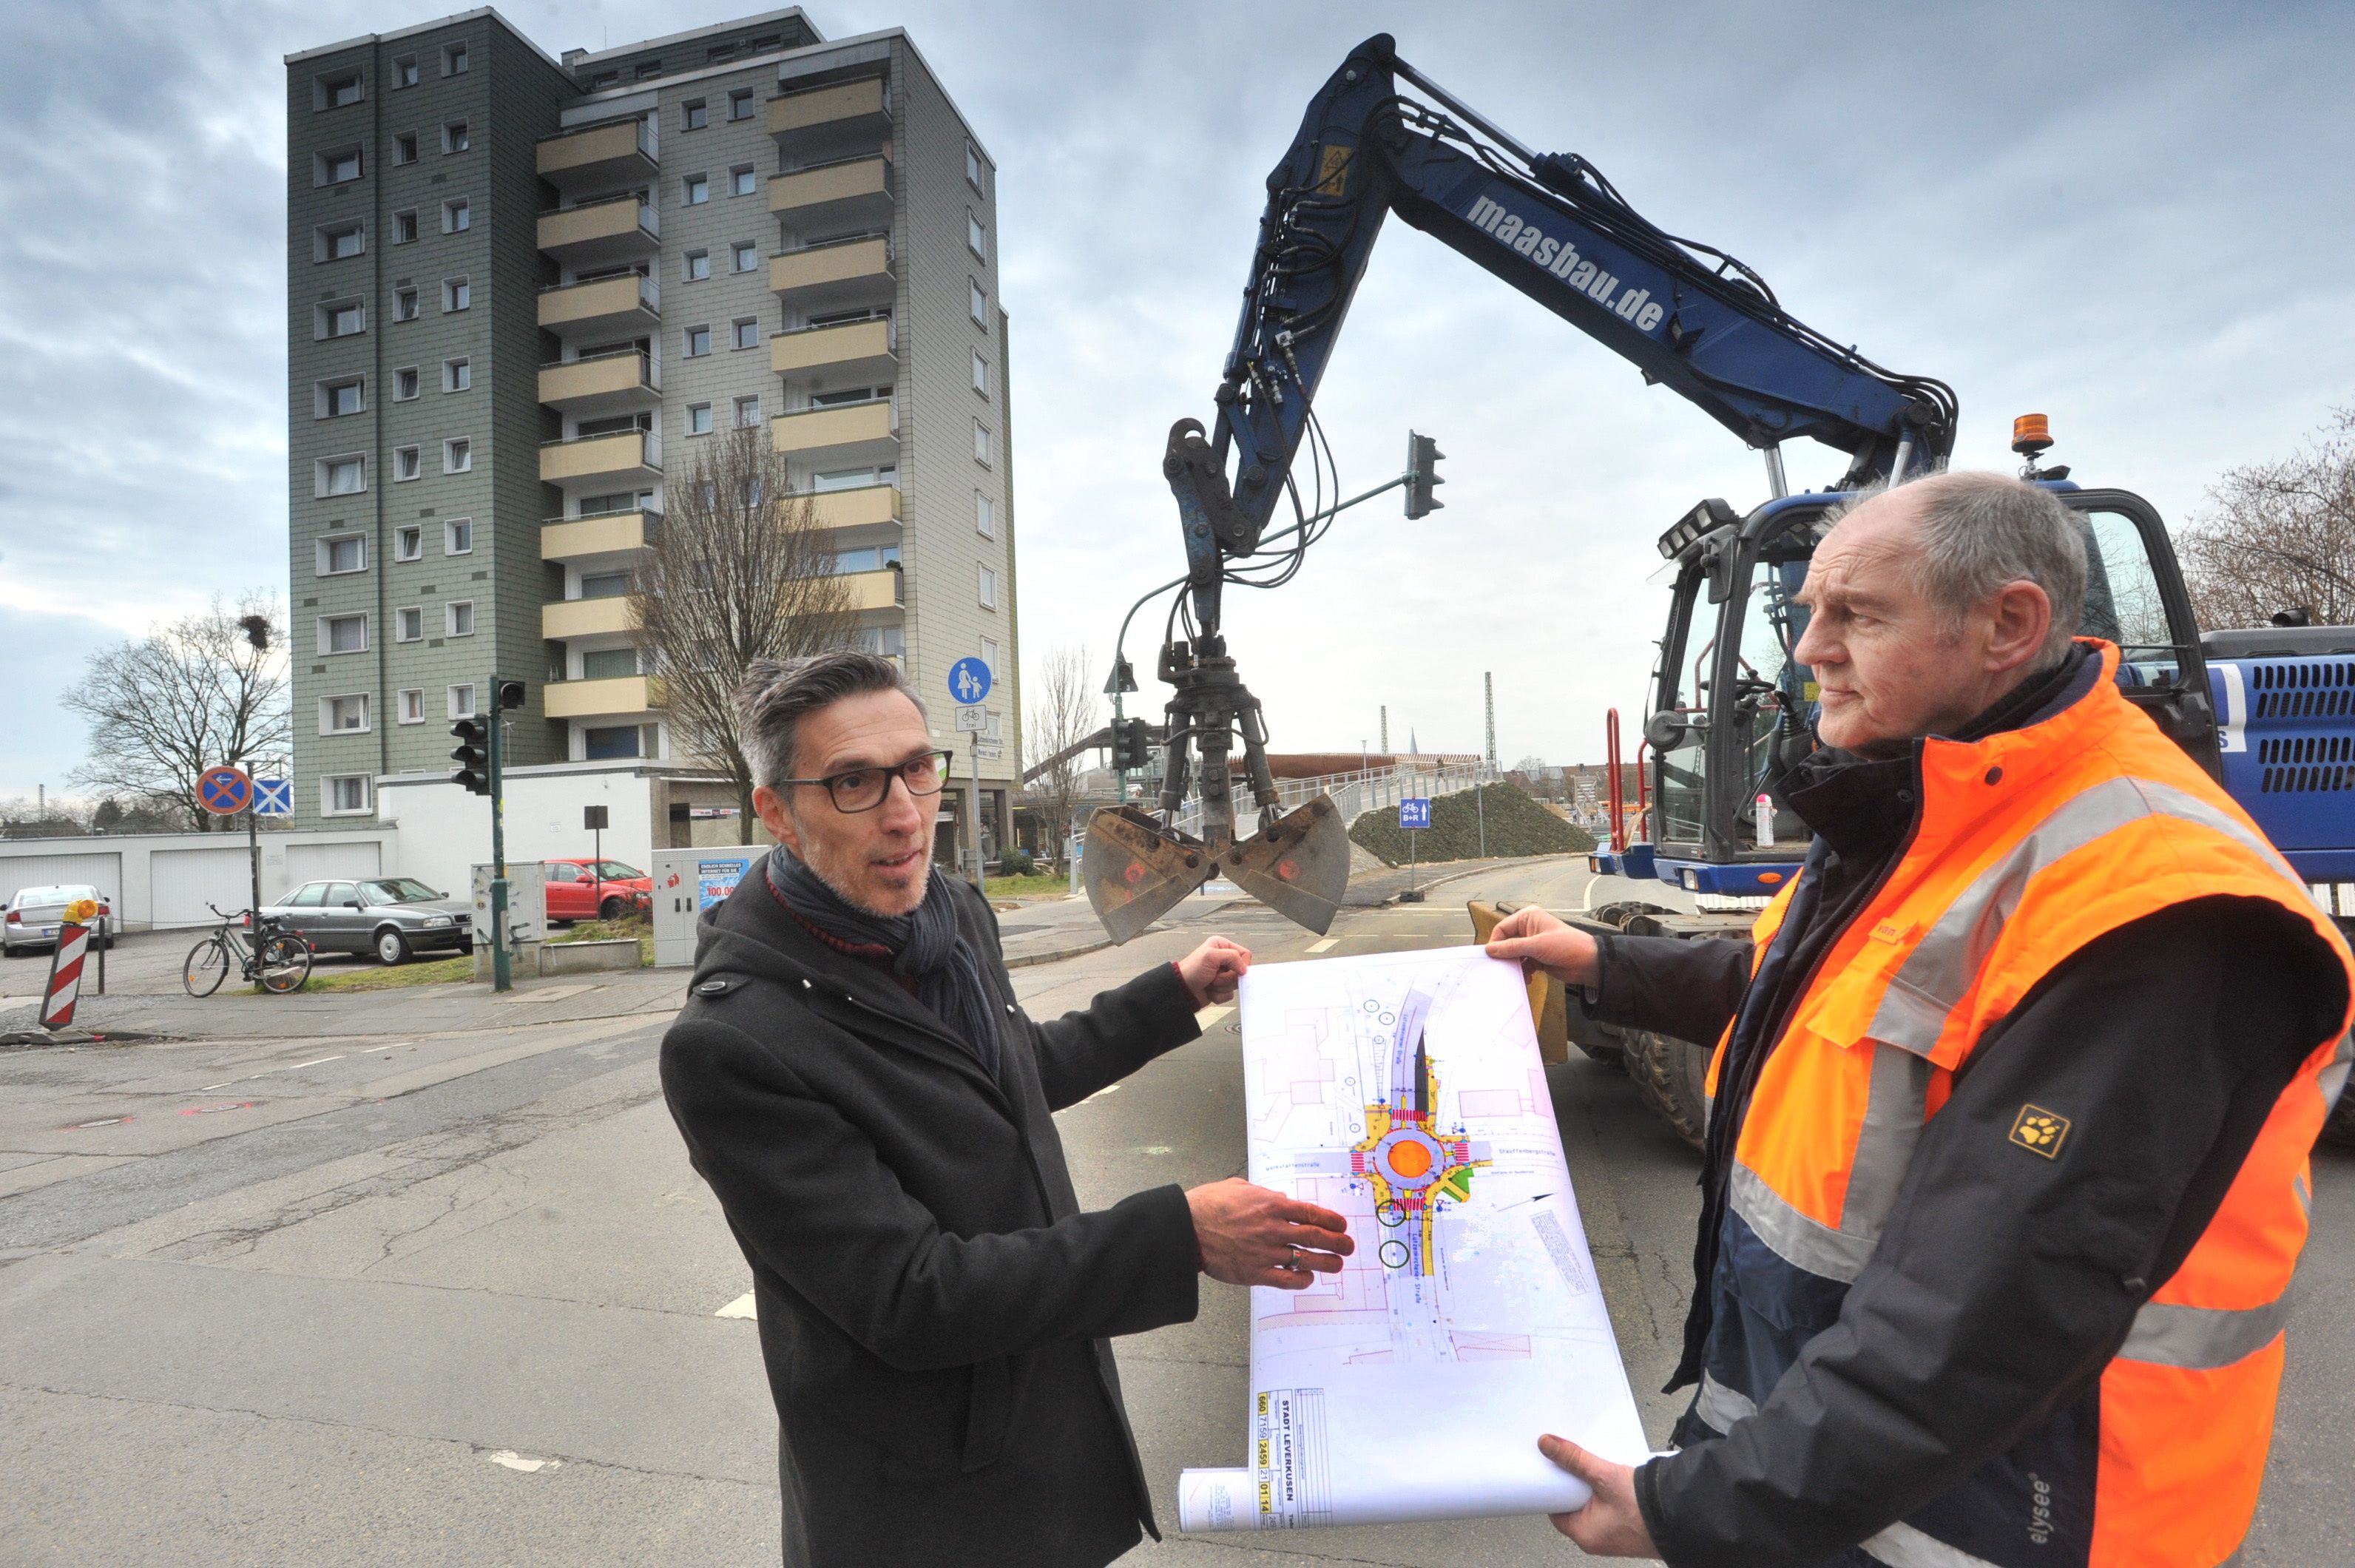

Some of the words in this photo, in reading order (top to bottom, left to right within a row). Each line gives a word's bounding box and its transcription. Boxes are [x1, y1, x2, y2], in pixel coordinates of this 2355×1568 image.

[1465, 195, 1664, 332] maasbau.de
[1283, 1400, 1291, 1430] STADT
[1260, 1470, 1268, 1480] 21
[1283, 1434, 1294, 1501] LEVERKUSEN
[1260, 1484, 1268, 1495] 01
[1261, 1501, 1269, 1513] 14
[2027, 1480, 2054, 1544] elysee
